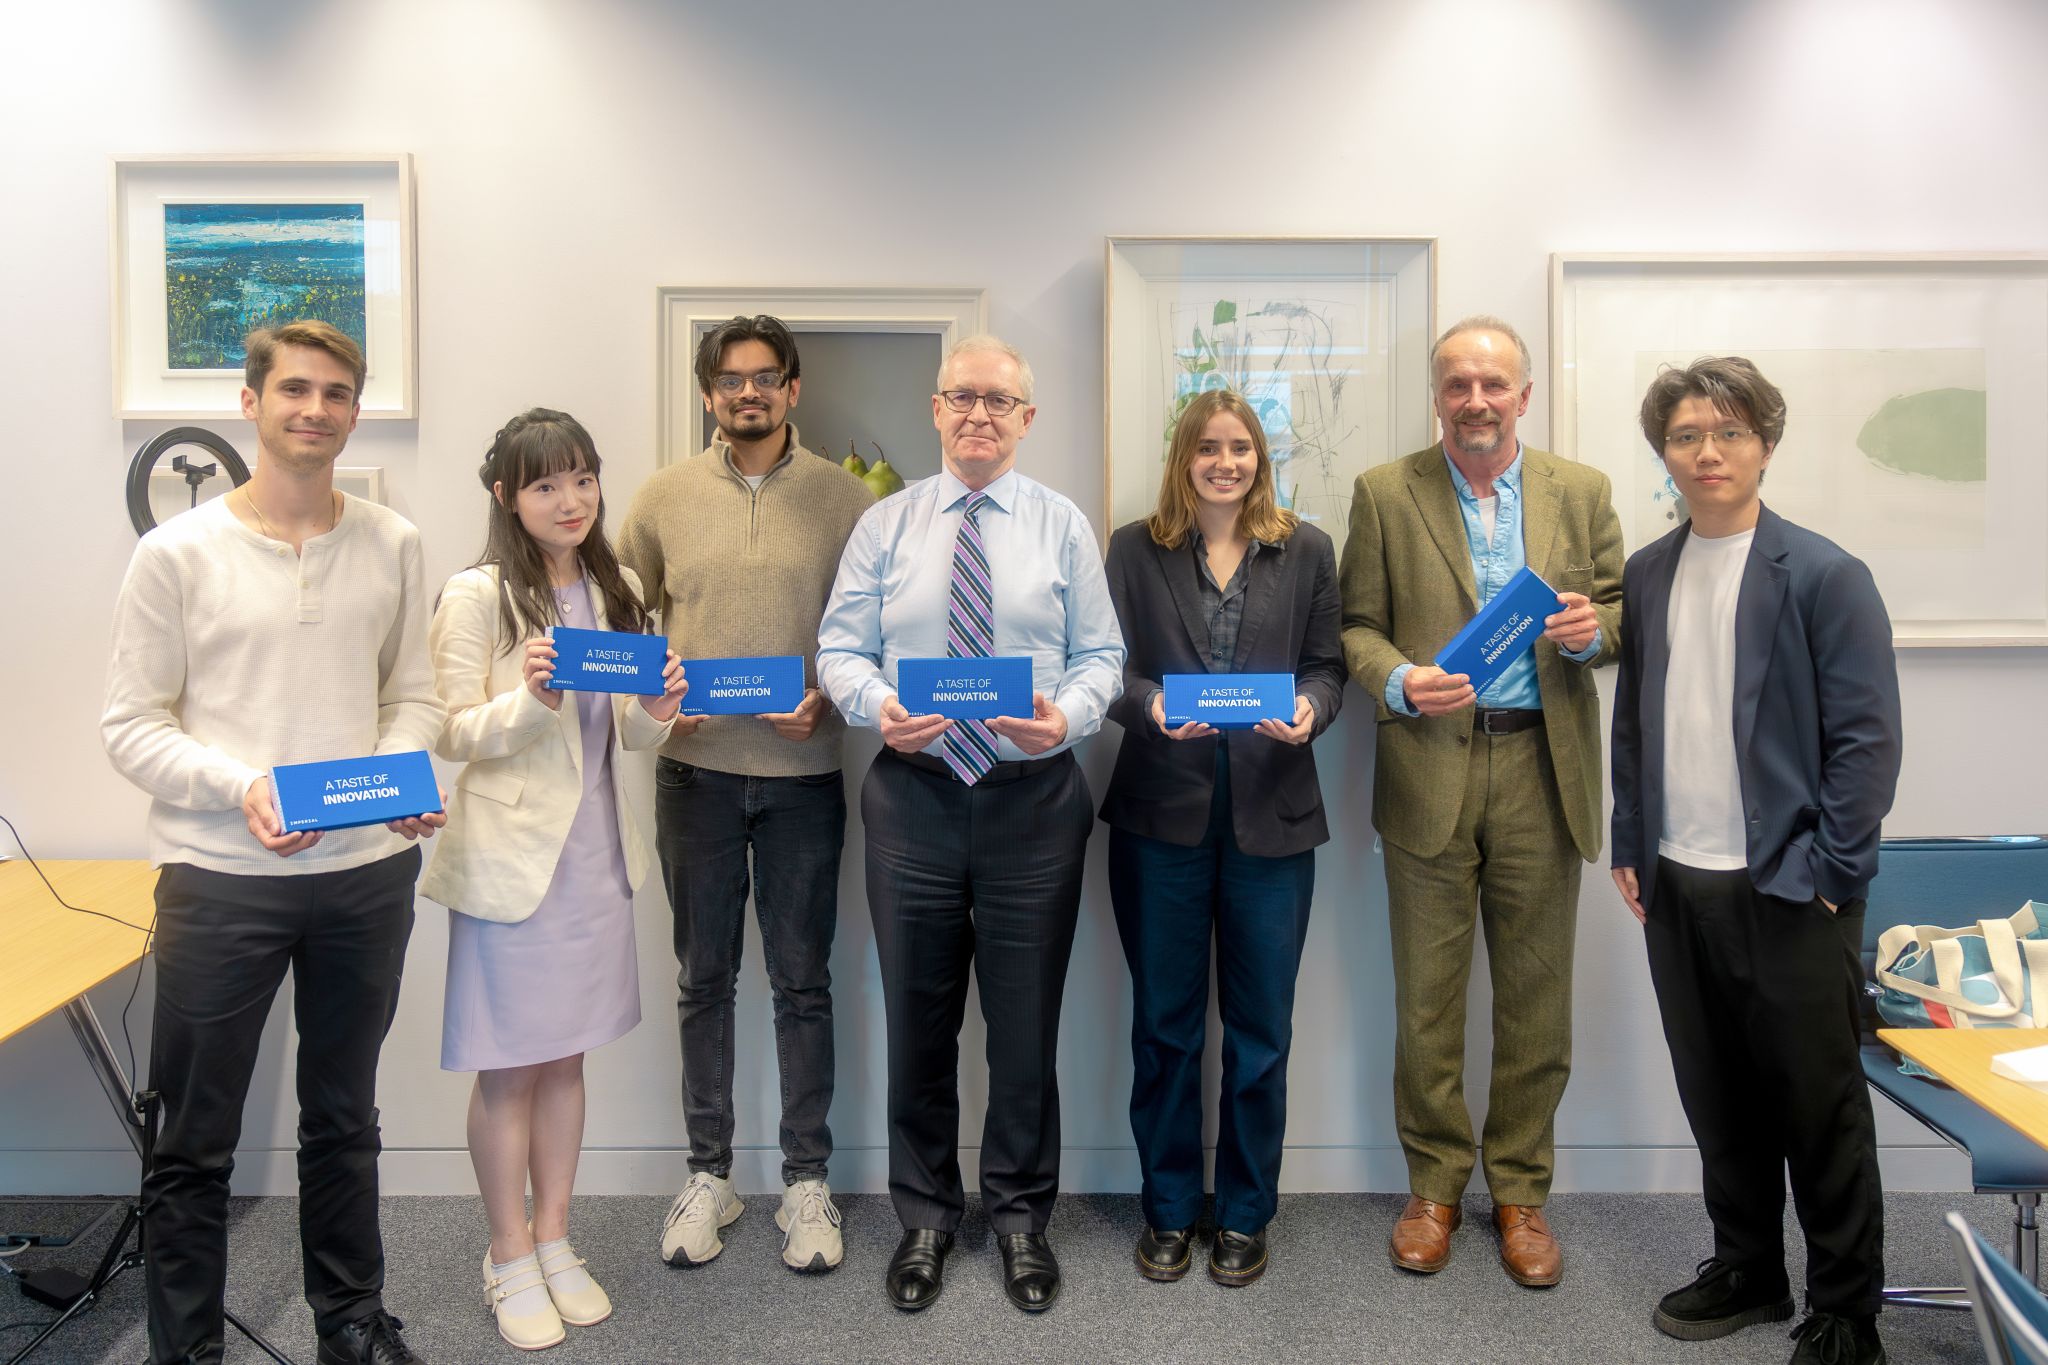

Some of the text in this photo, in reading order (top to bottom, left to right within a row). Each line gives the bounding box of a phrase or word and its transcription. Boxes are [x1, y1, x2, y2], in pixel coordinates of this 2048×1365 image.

[1480, 612, 1521, 656] A TASTE OF
[1484, 615, 1534, 665] INNOVATION
[586, 649, 635, 661] A TASTE OF
[582, 662, 638, 675] INNOVATION
[713, 676, 765, 686] A TASTE OF
[936, 678, 992, 689] A TASTE OF
[710, 687, 771, 698] INNOVATION
[932, 691, 998, 702] INNOVATION
[1201, 688, 1255, 697] A TASTE OF
[1198, 699, 1261, 708] INNOVATION
[325, 774, 389, 791] A TASTE OF
[323, 786, 400, 805] INNOVATION
